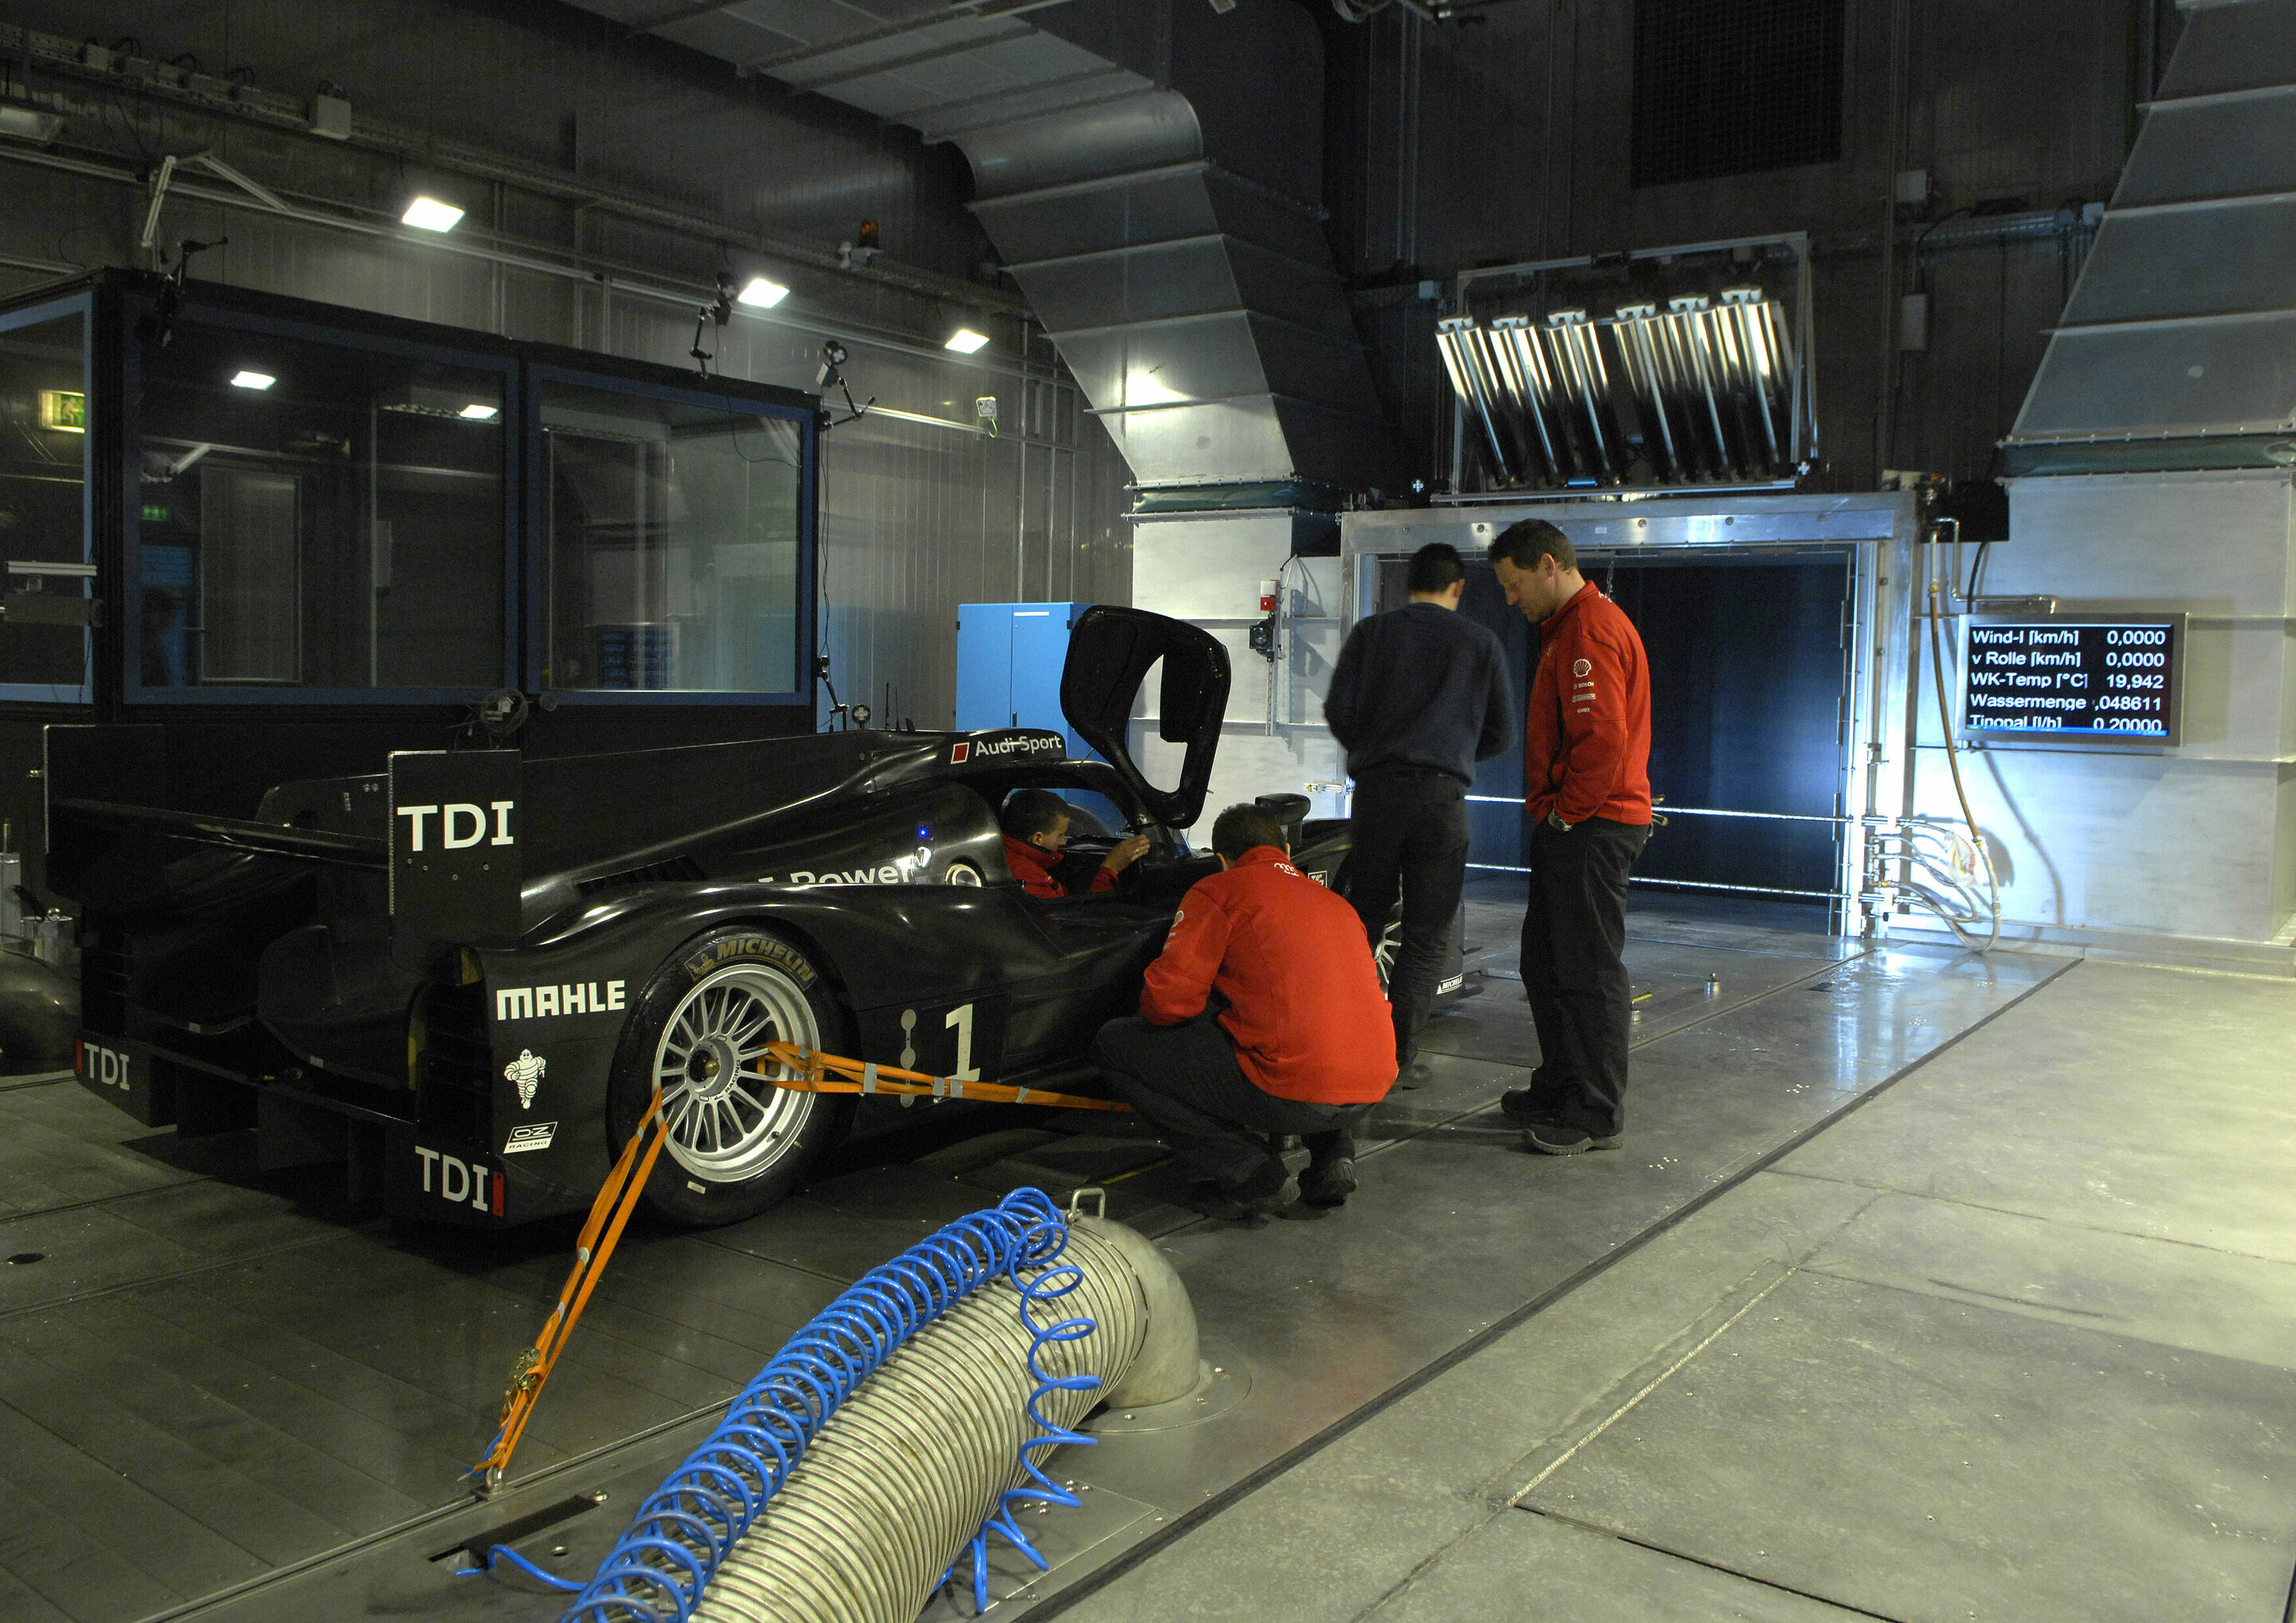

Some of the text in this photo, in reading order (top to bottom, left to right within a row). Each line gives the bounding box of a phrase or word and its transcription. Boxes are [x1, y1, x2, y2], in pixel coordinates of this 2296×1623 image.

[2029, 630, 2079, 646] [km/h]
[2106, 630, 2166, 646] 0,0000
[1972, 651, 2165, 668] v Rolle [km/h] 0,0000
[1970, 672, 2052, 688] WK-Temp
[2106, 674, 2164, 690] 19,942
[1969, 693, 2087, 711] Wassermenge
[1969, 714, 2028, 729] Tinopal
[975, 735, 1063, 756] Audi Sport
[397, 800, 514, 851] TDI
[718, 938, 816, 982] MICHELIN
[496, 980, 626, 1021] MAHLE
[946, 1003, 981, 1082] 1
[83, 1042, 130, 1091] TDI
[509, 1141, 548, 1149] RACING
[415, 1145, 488, 1212] TDI
